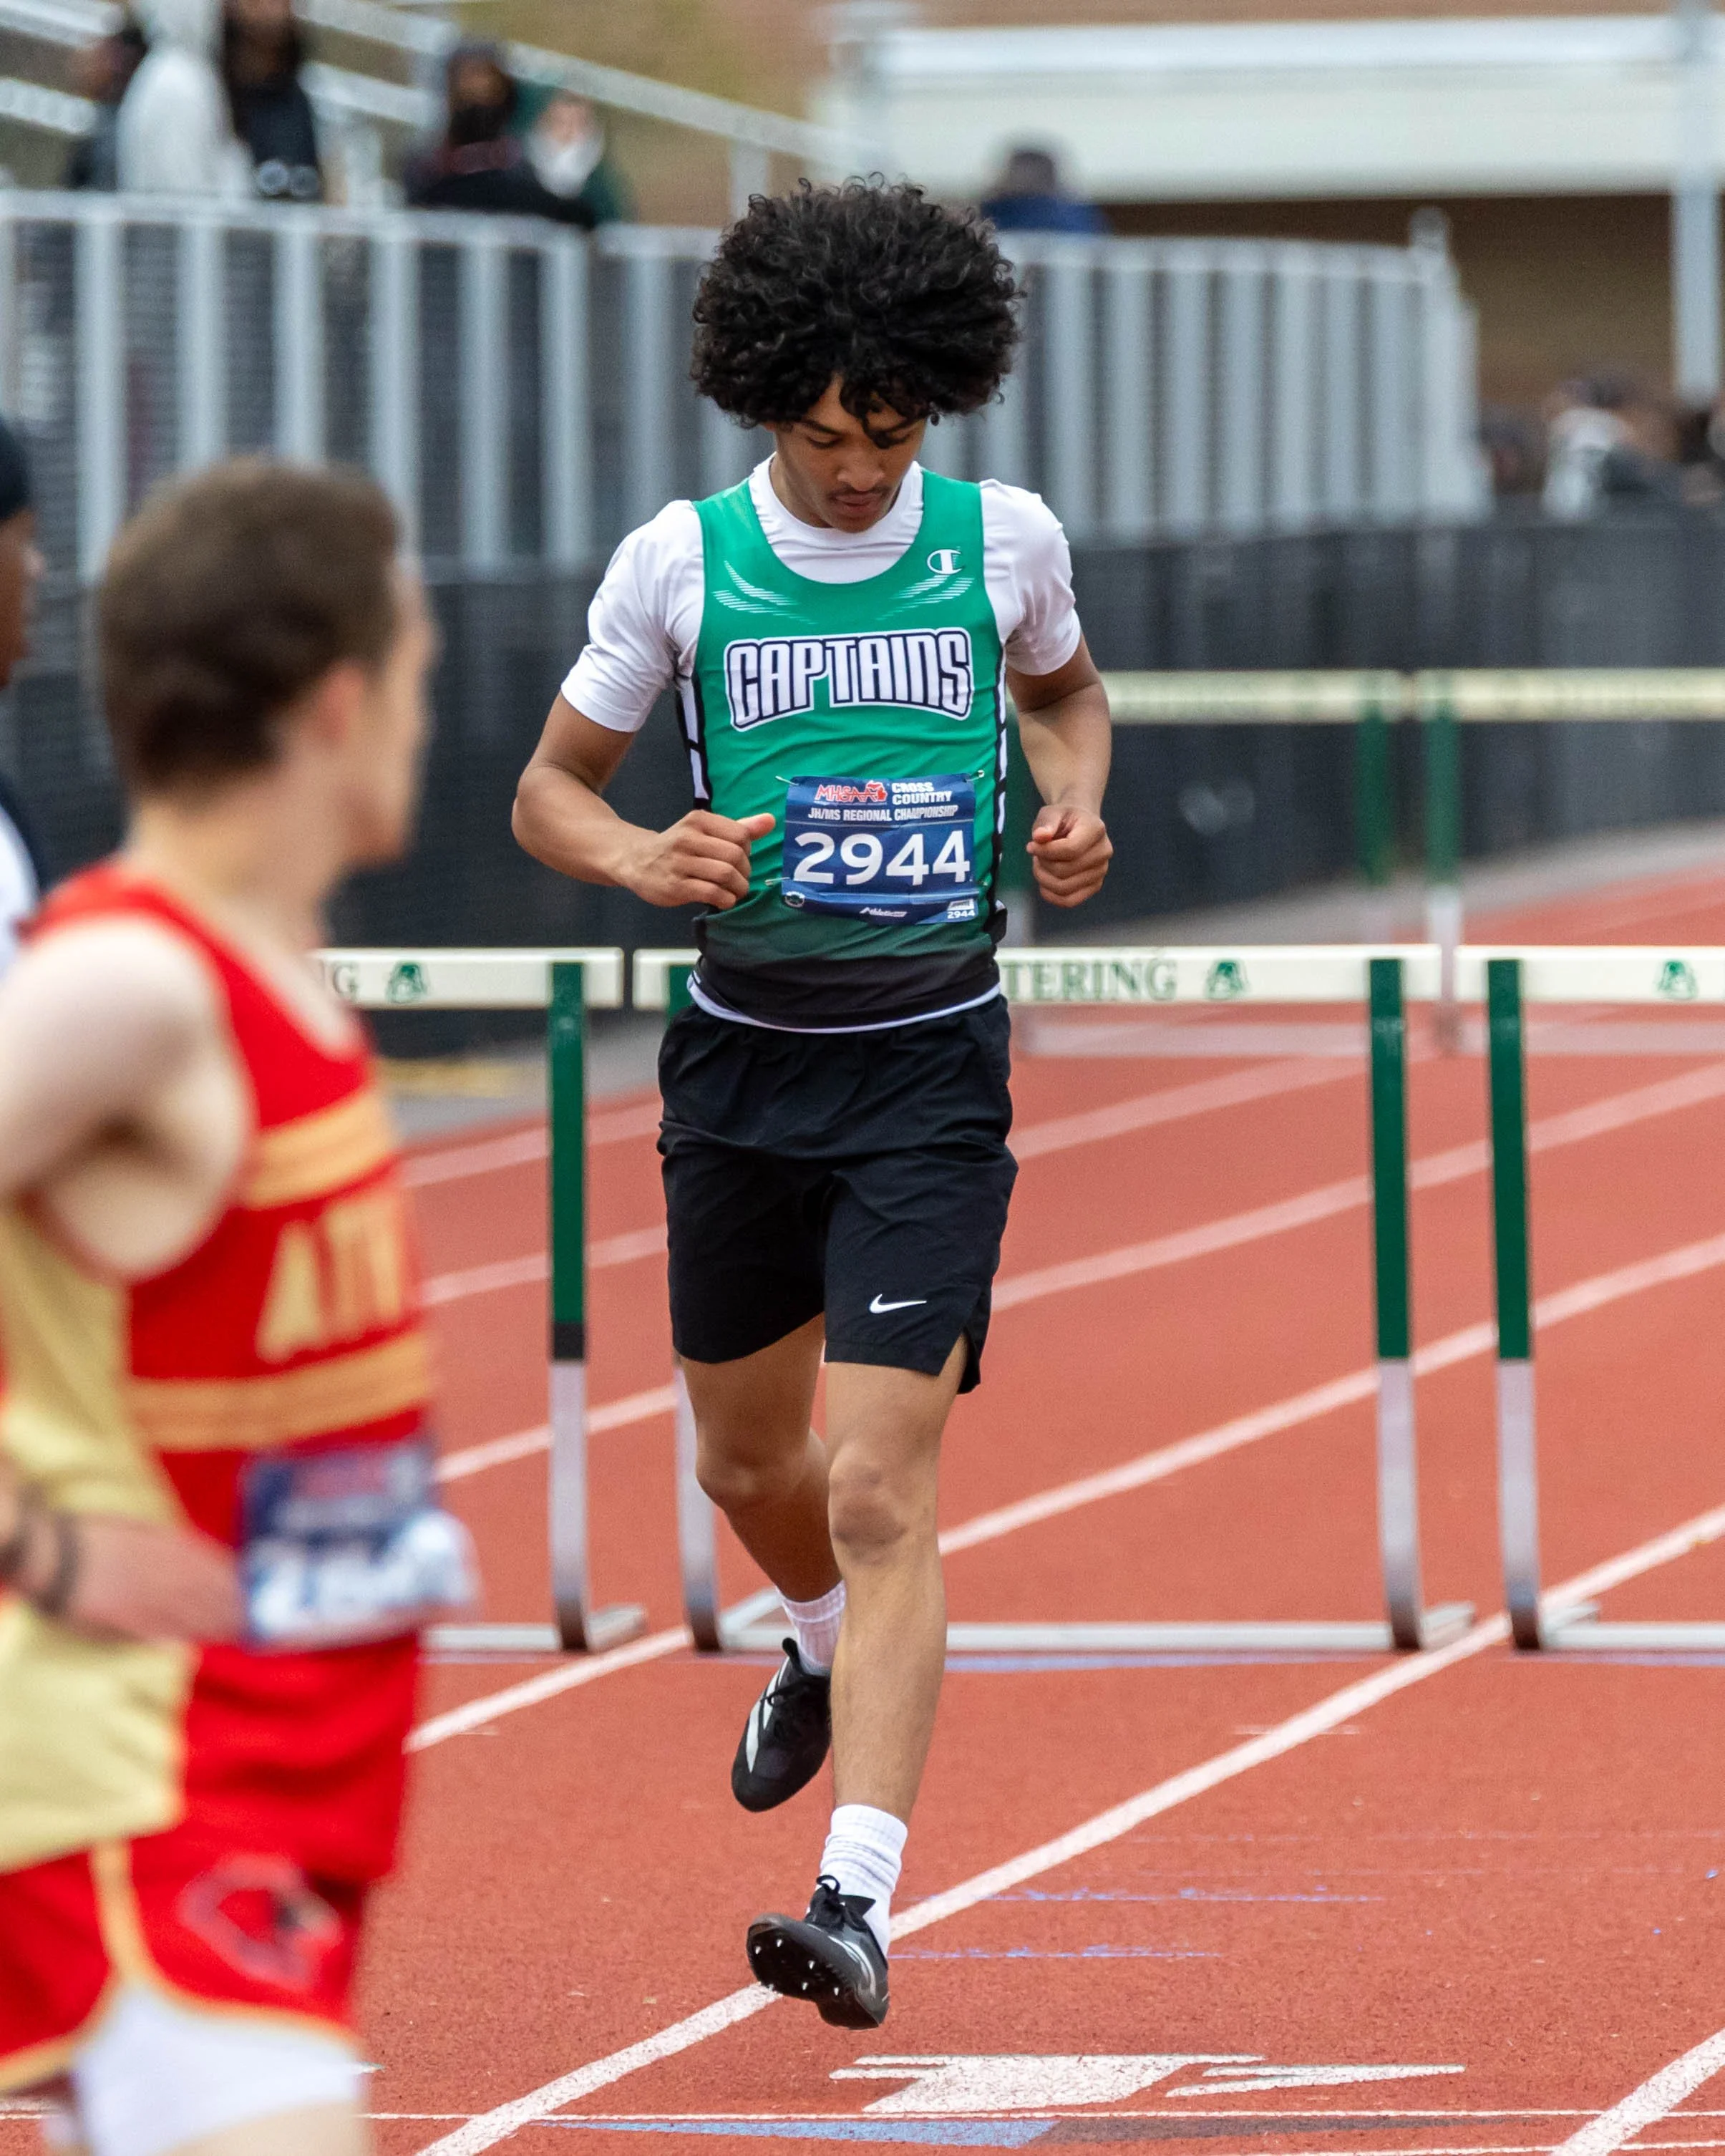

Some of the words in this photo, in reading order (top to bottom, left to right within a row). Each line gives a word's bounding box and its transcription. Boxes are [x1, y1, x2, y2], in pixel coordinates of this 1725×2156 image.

[724, 628, 973, 731] CAPTAINS
[814, 783, 883, 802] MHSAA
[891, 782, 934, 793] CROSS
[892, 791, 952, 805] COUNTRY
[807, 807, 841, 821] JH/MS
[843, 809, 893, 822] REGIONAL
[894, 805, 958, 821] CHAMPIONSHIP
[793, 830, 971, 886] 2944
[947, 910, 976, 919] 2944
